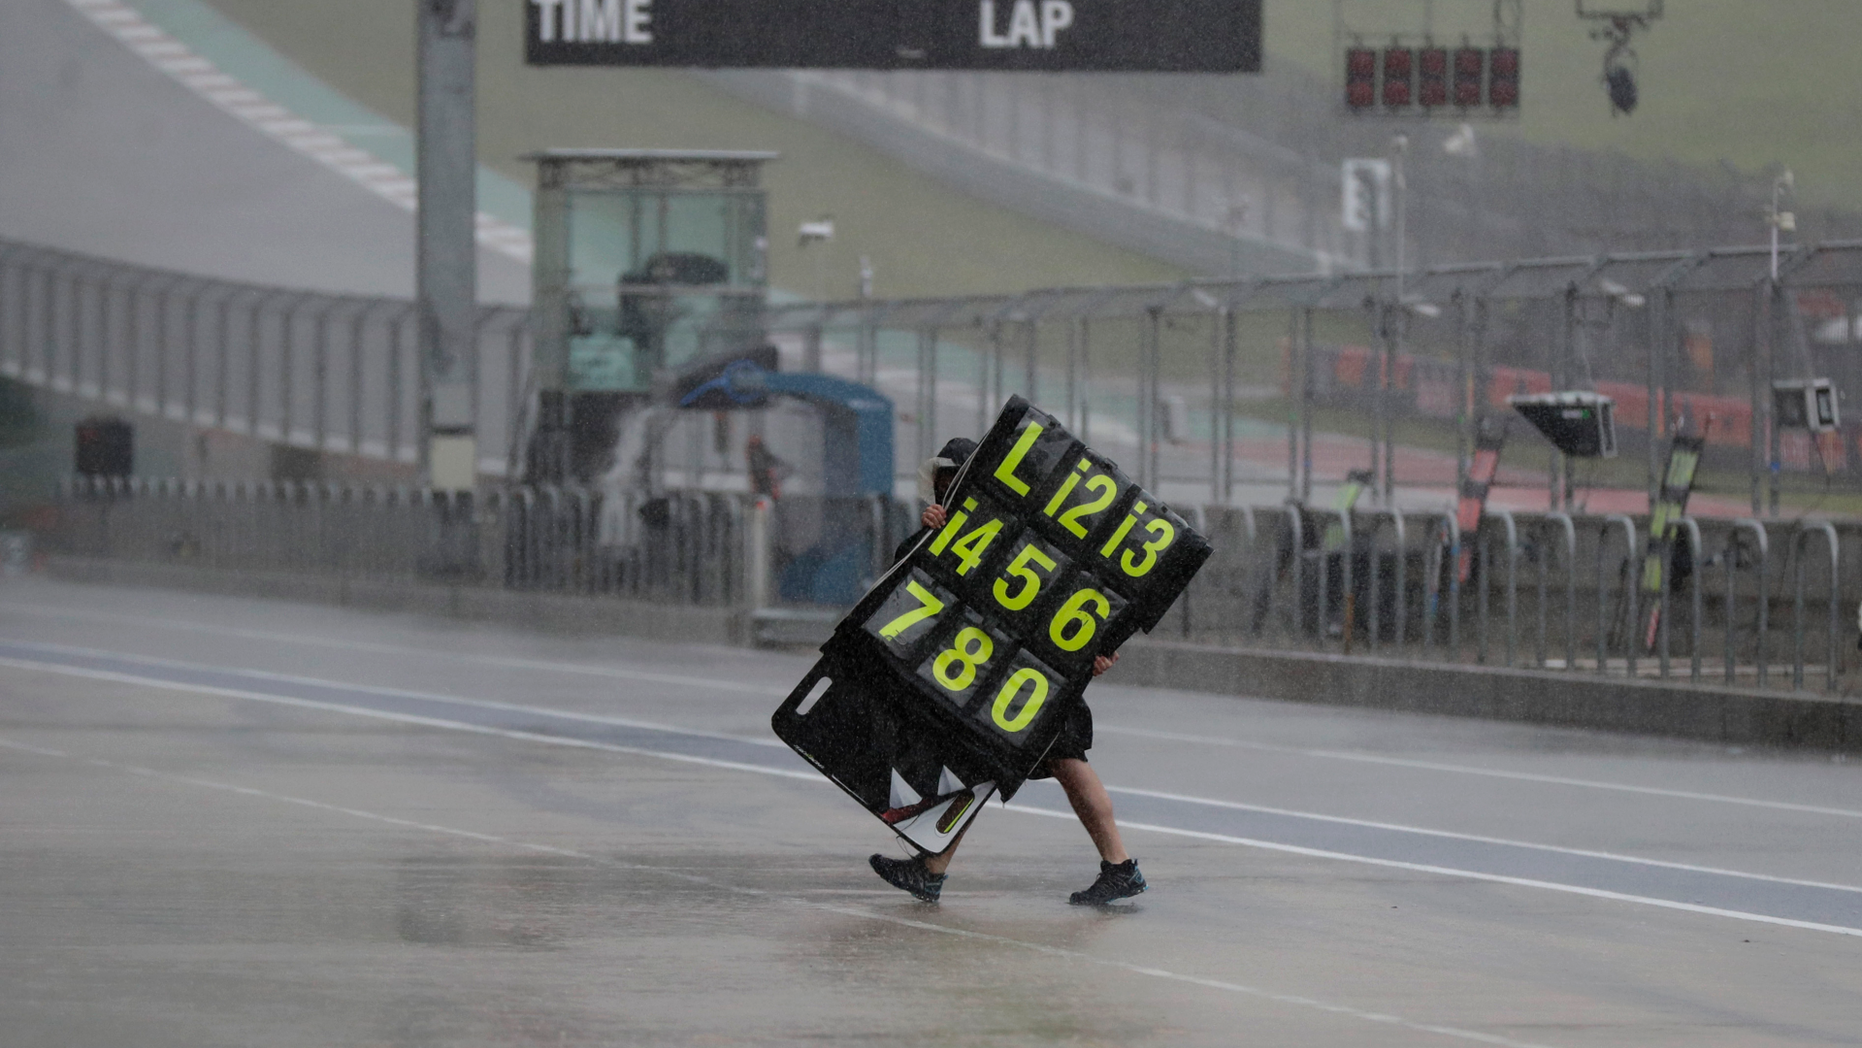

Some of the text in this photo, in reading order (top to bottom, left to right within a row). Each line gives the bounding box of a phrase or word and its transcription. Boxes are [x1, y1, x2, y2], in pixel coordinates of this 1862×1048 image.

[533, 0, 653, 43] TIME
[980, 0, 1073, 47] LAP
[993, 421, 1044, 497] L
[993, 543, 1057, 611] 5
[1048, 588, 1111, 652] 6
[879, 580, 1049, 733] 7 8 0
